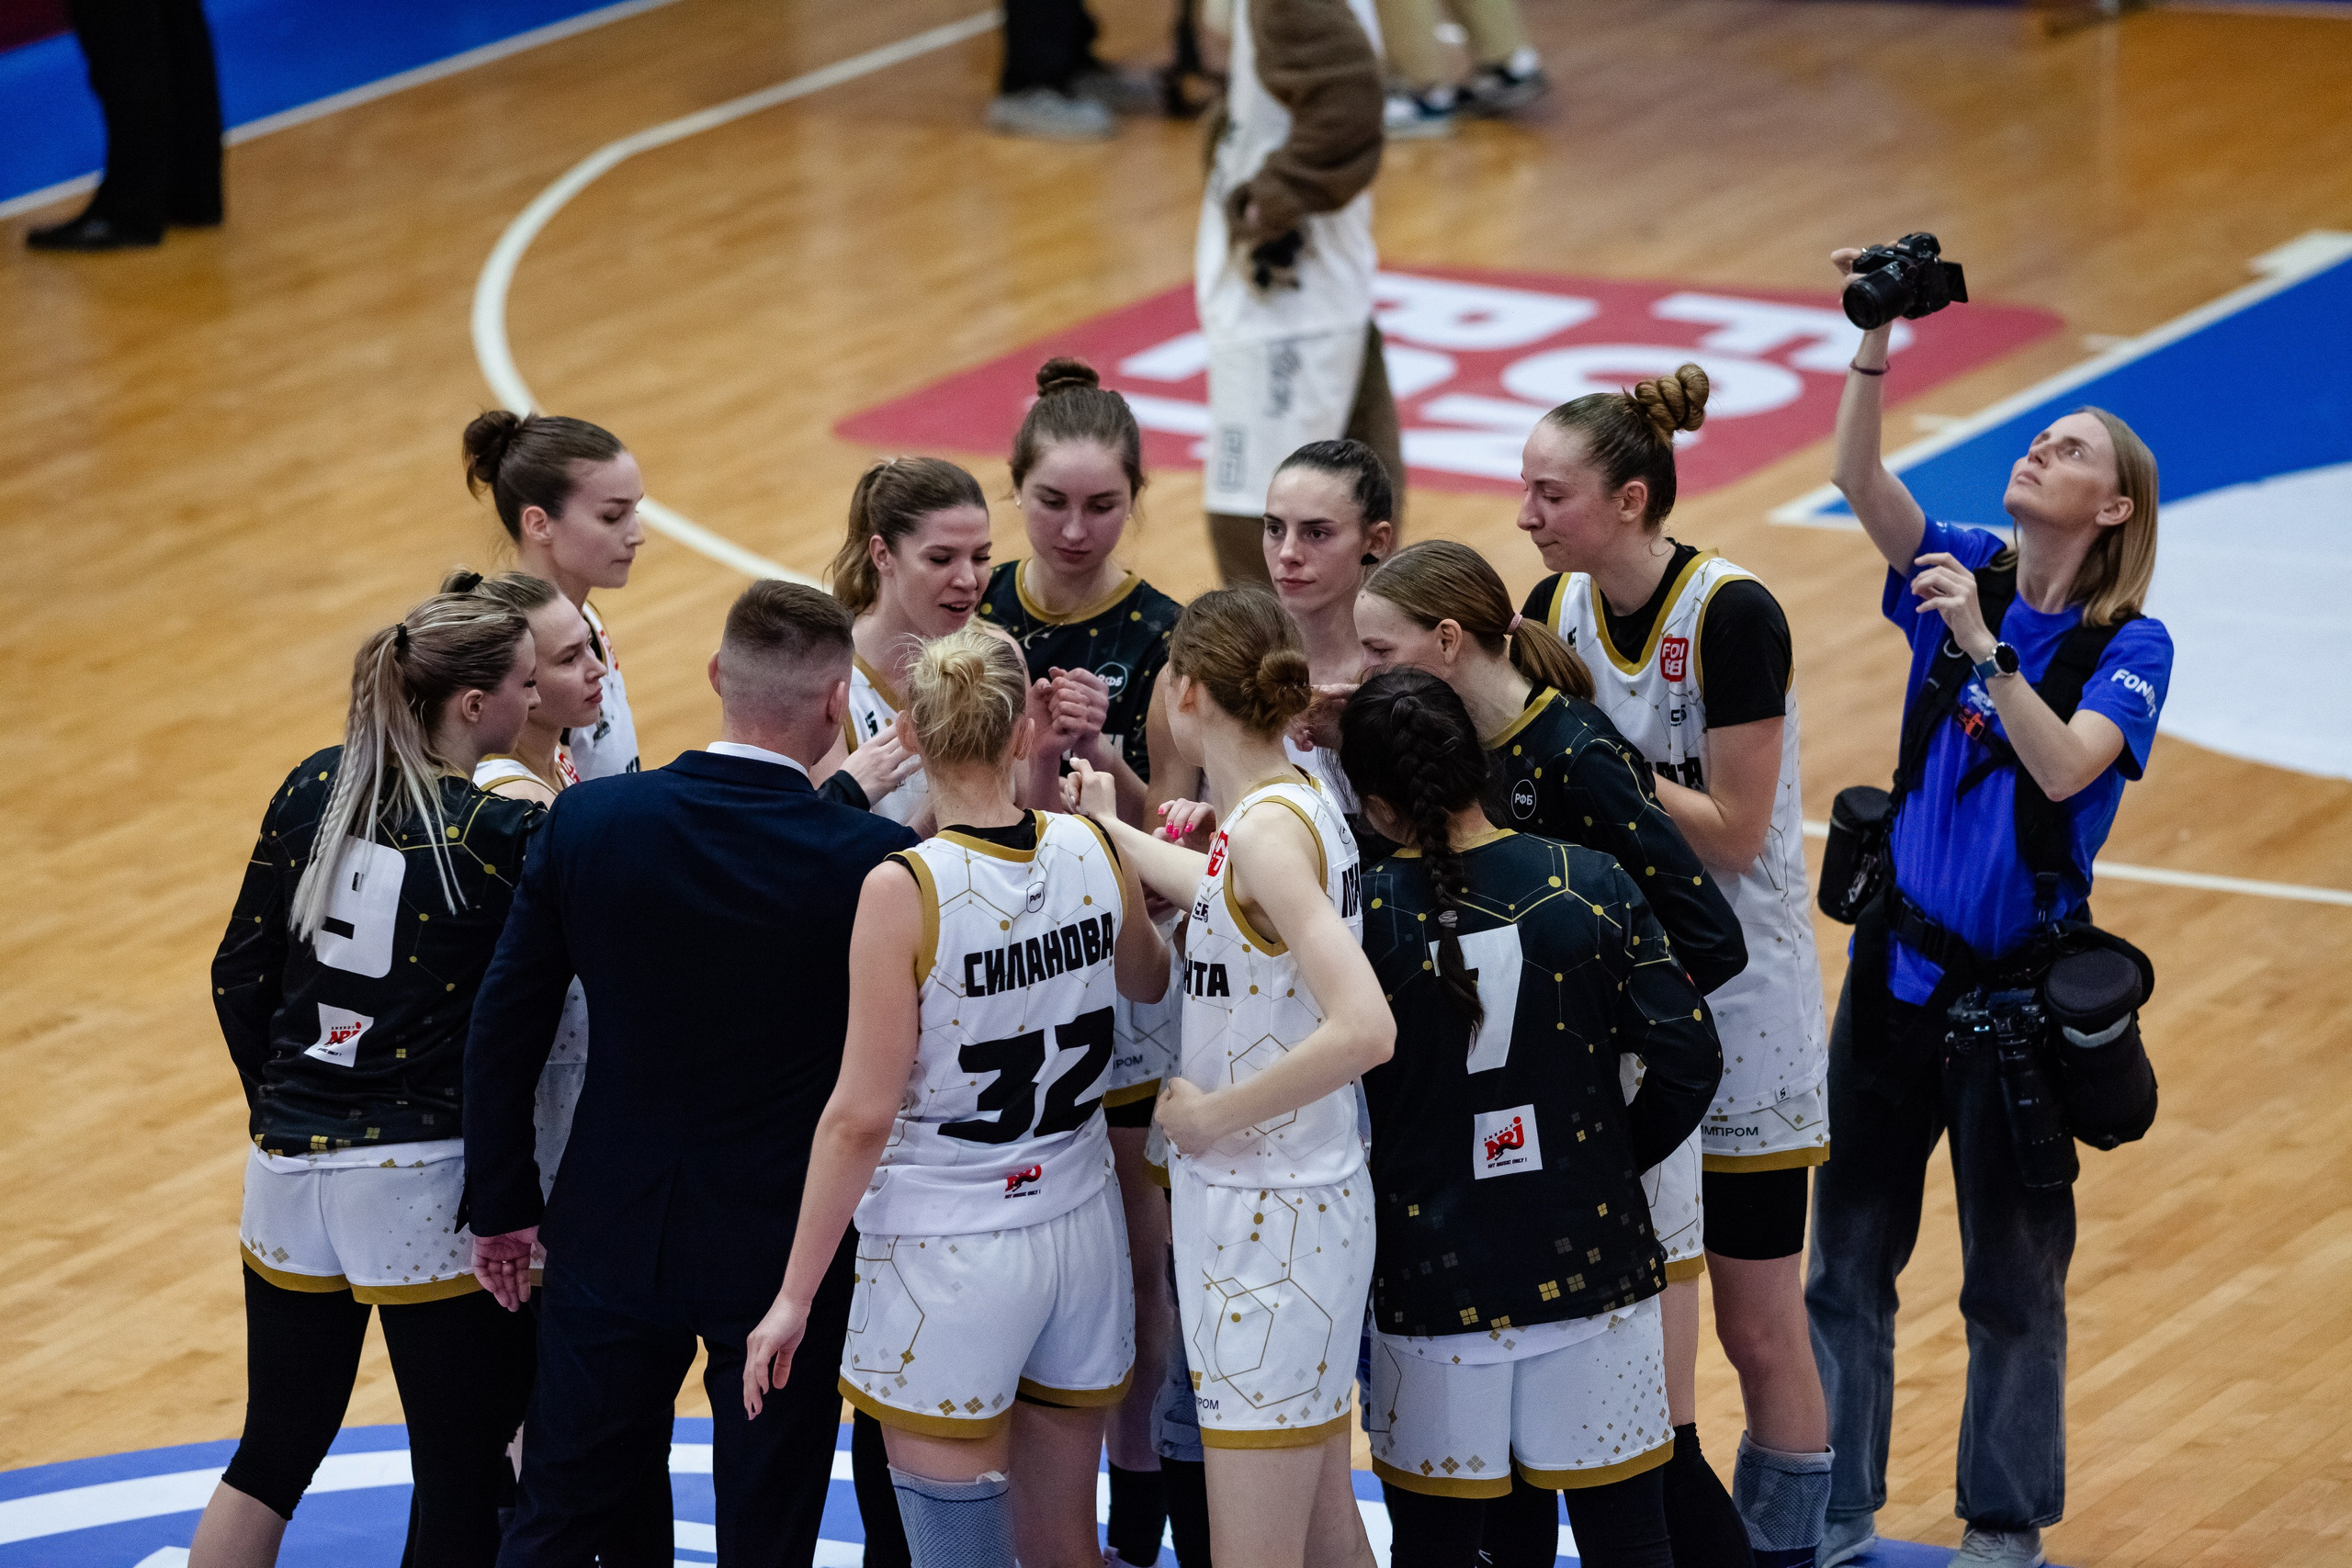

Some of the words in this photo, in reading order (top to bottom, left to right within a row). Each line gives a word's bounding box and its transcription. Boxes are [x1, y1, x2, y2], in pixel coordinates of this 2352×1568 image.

[1514, 793, 1533, 806] РФБ
[316, 833, 406, 979] 9
[964, 912, 1114, 998] СИЛАНОВА
[1428, 923, 1524, 1076] 7
[936, 1005, 1115, 1145] 32
